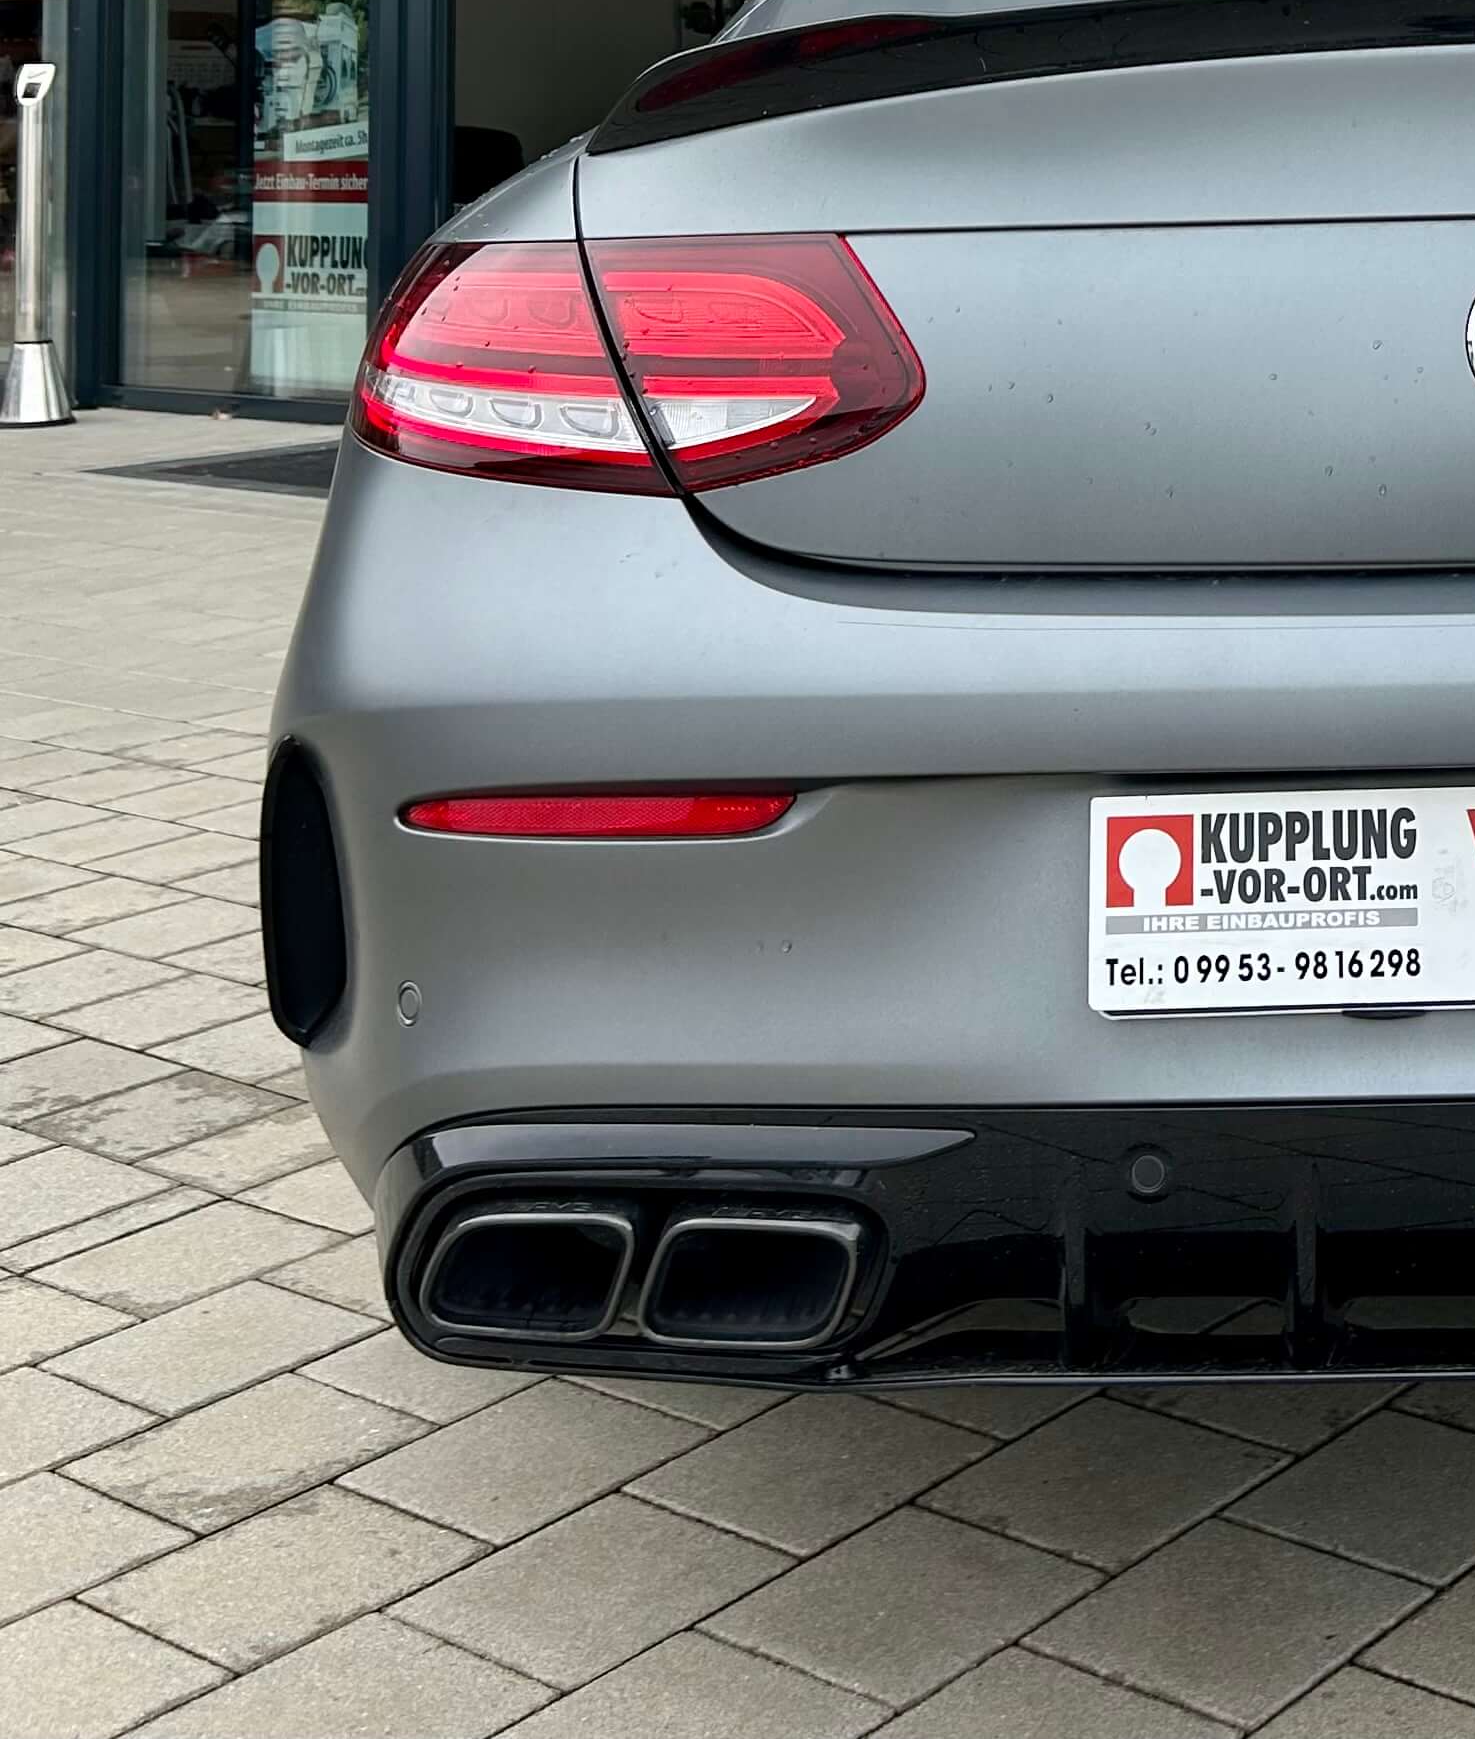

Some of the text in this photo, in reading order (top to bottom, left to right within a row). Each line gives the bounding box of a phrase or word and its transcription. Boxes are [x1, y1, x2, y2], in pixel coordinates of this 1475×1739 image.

[1200, 807, 1417, 864] KUPPLUNG
[1200, 865, 1418, 905] -VOR-ORT.com
[1144, 909, 1381, 933] IHRE EINBAUPROFIS
[1106, 957, 1164, 987] Tel.:
